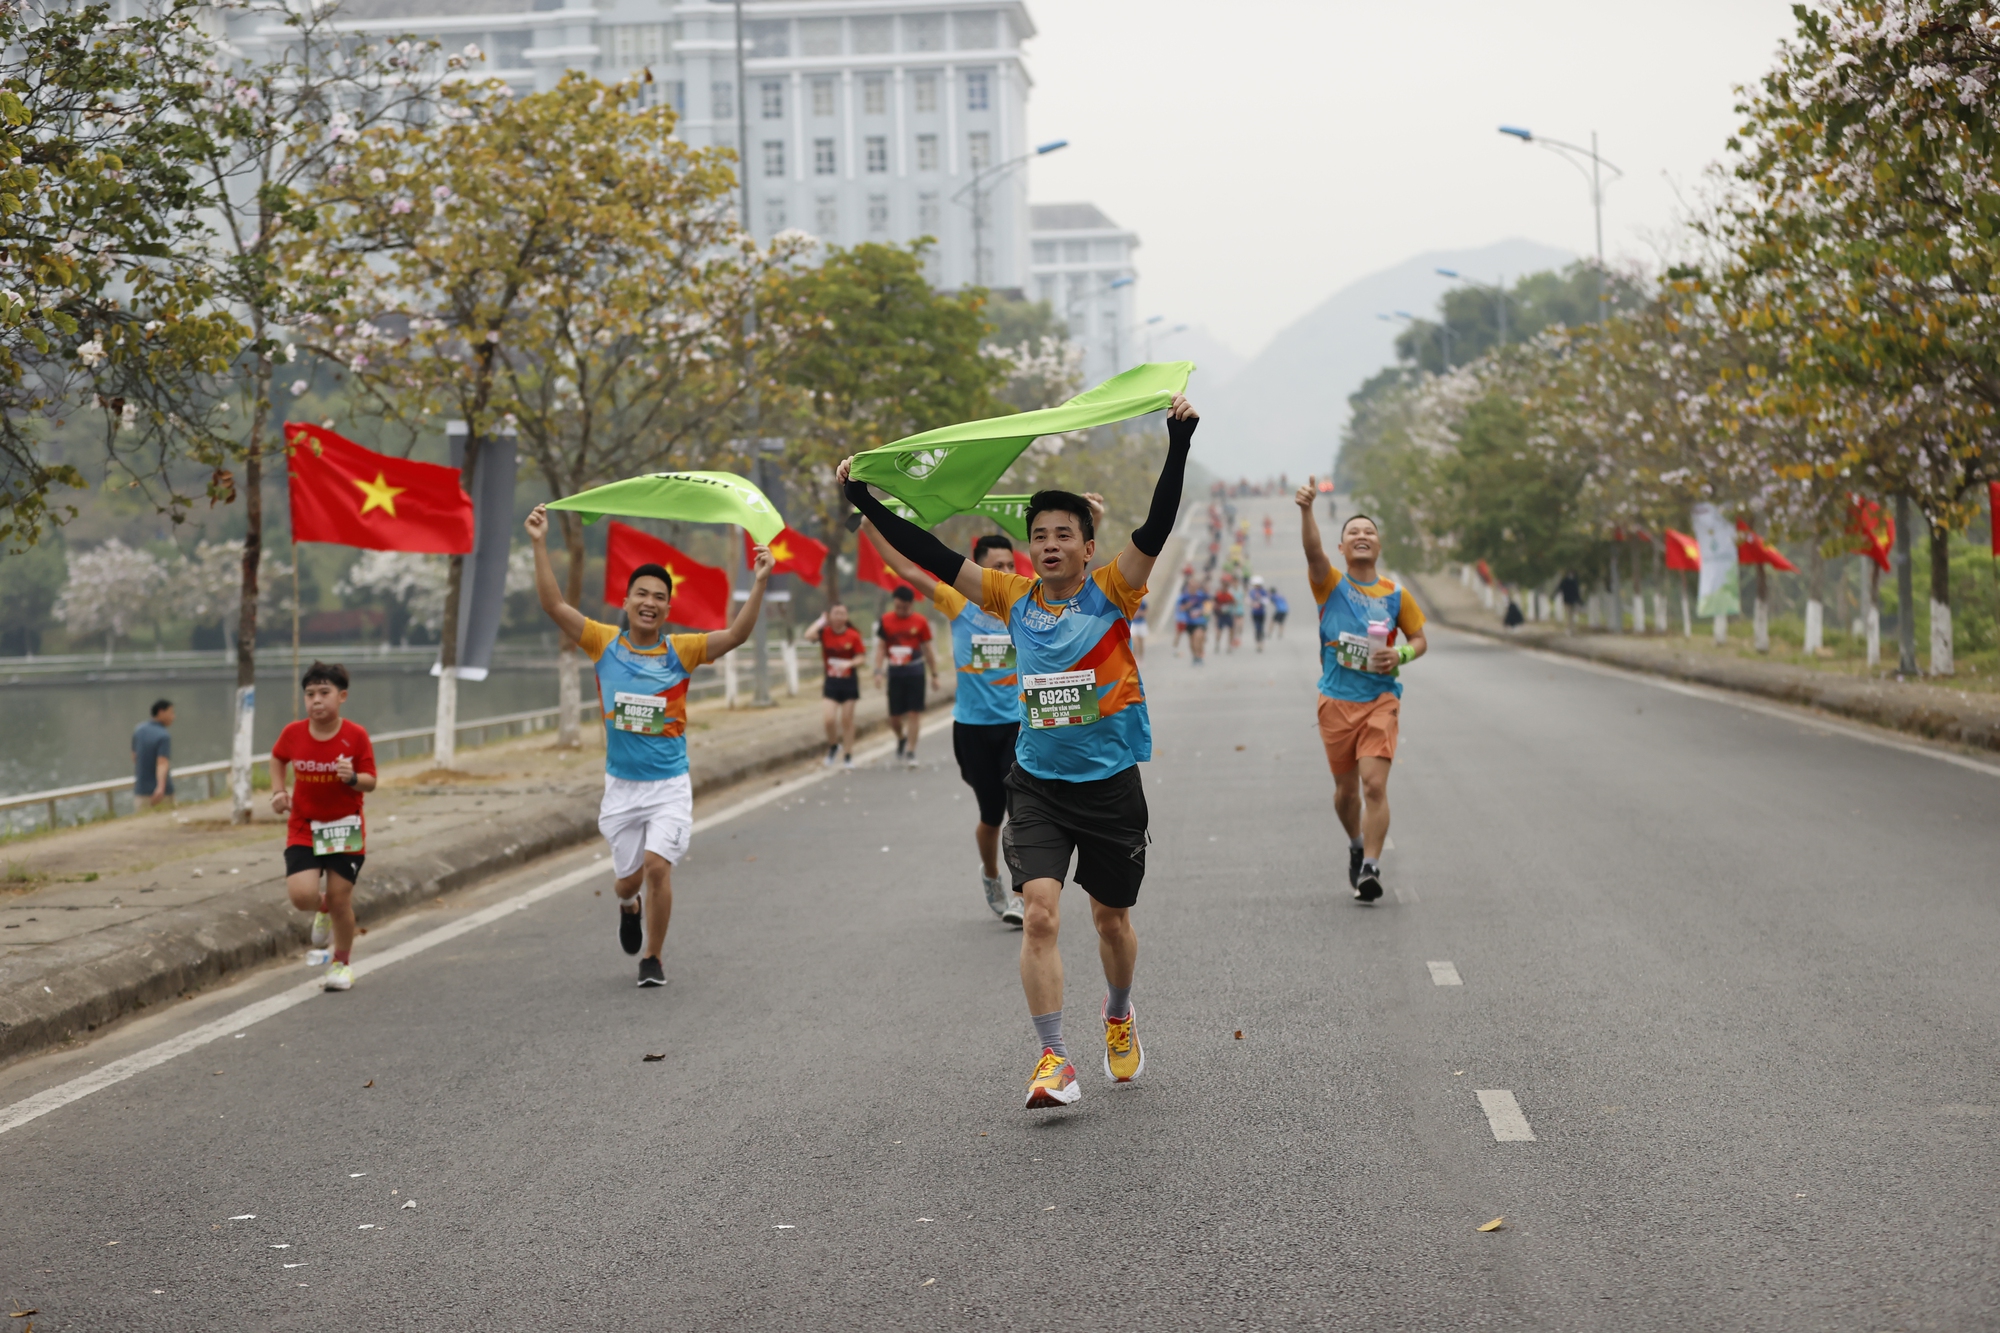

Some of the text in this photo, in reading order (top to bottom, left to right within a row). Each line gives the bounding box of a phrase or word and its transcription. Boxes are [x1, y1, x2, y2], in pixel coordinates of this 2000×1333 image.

[1039, 688, 1080, 705] 69263
[625, 705, 654, 718] 60822
[1031, 708, 1039, 718] B
